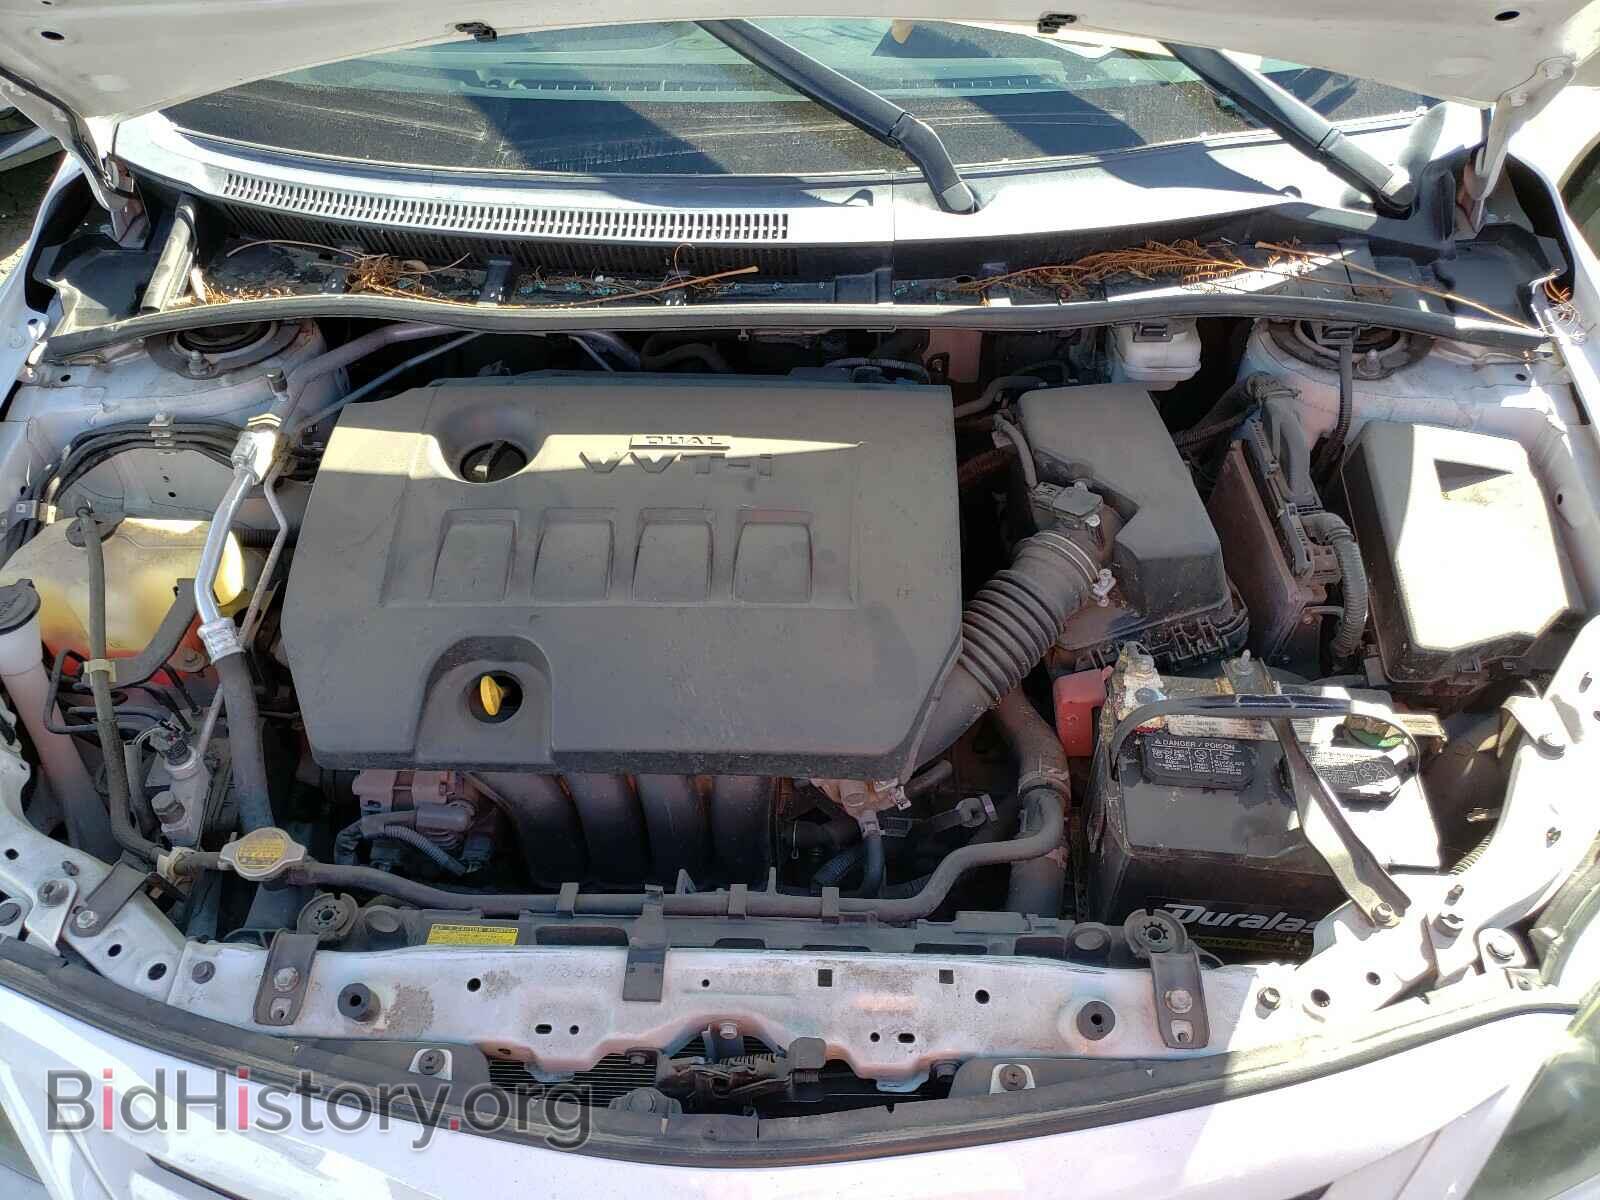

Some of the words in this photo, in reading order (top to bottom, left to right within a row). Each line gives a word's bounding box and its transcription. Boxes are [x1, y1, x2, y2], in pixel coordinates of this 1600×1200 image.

[644, 435, 723, 446] DUAL
[1162, 739, 1196, 748] DANGER
[1204, 742, 1235, 750] POISON
